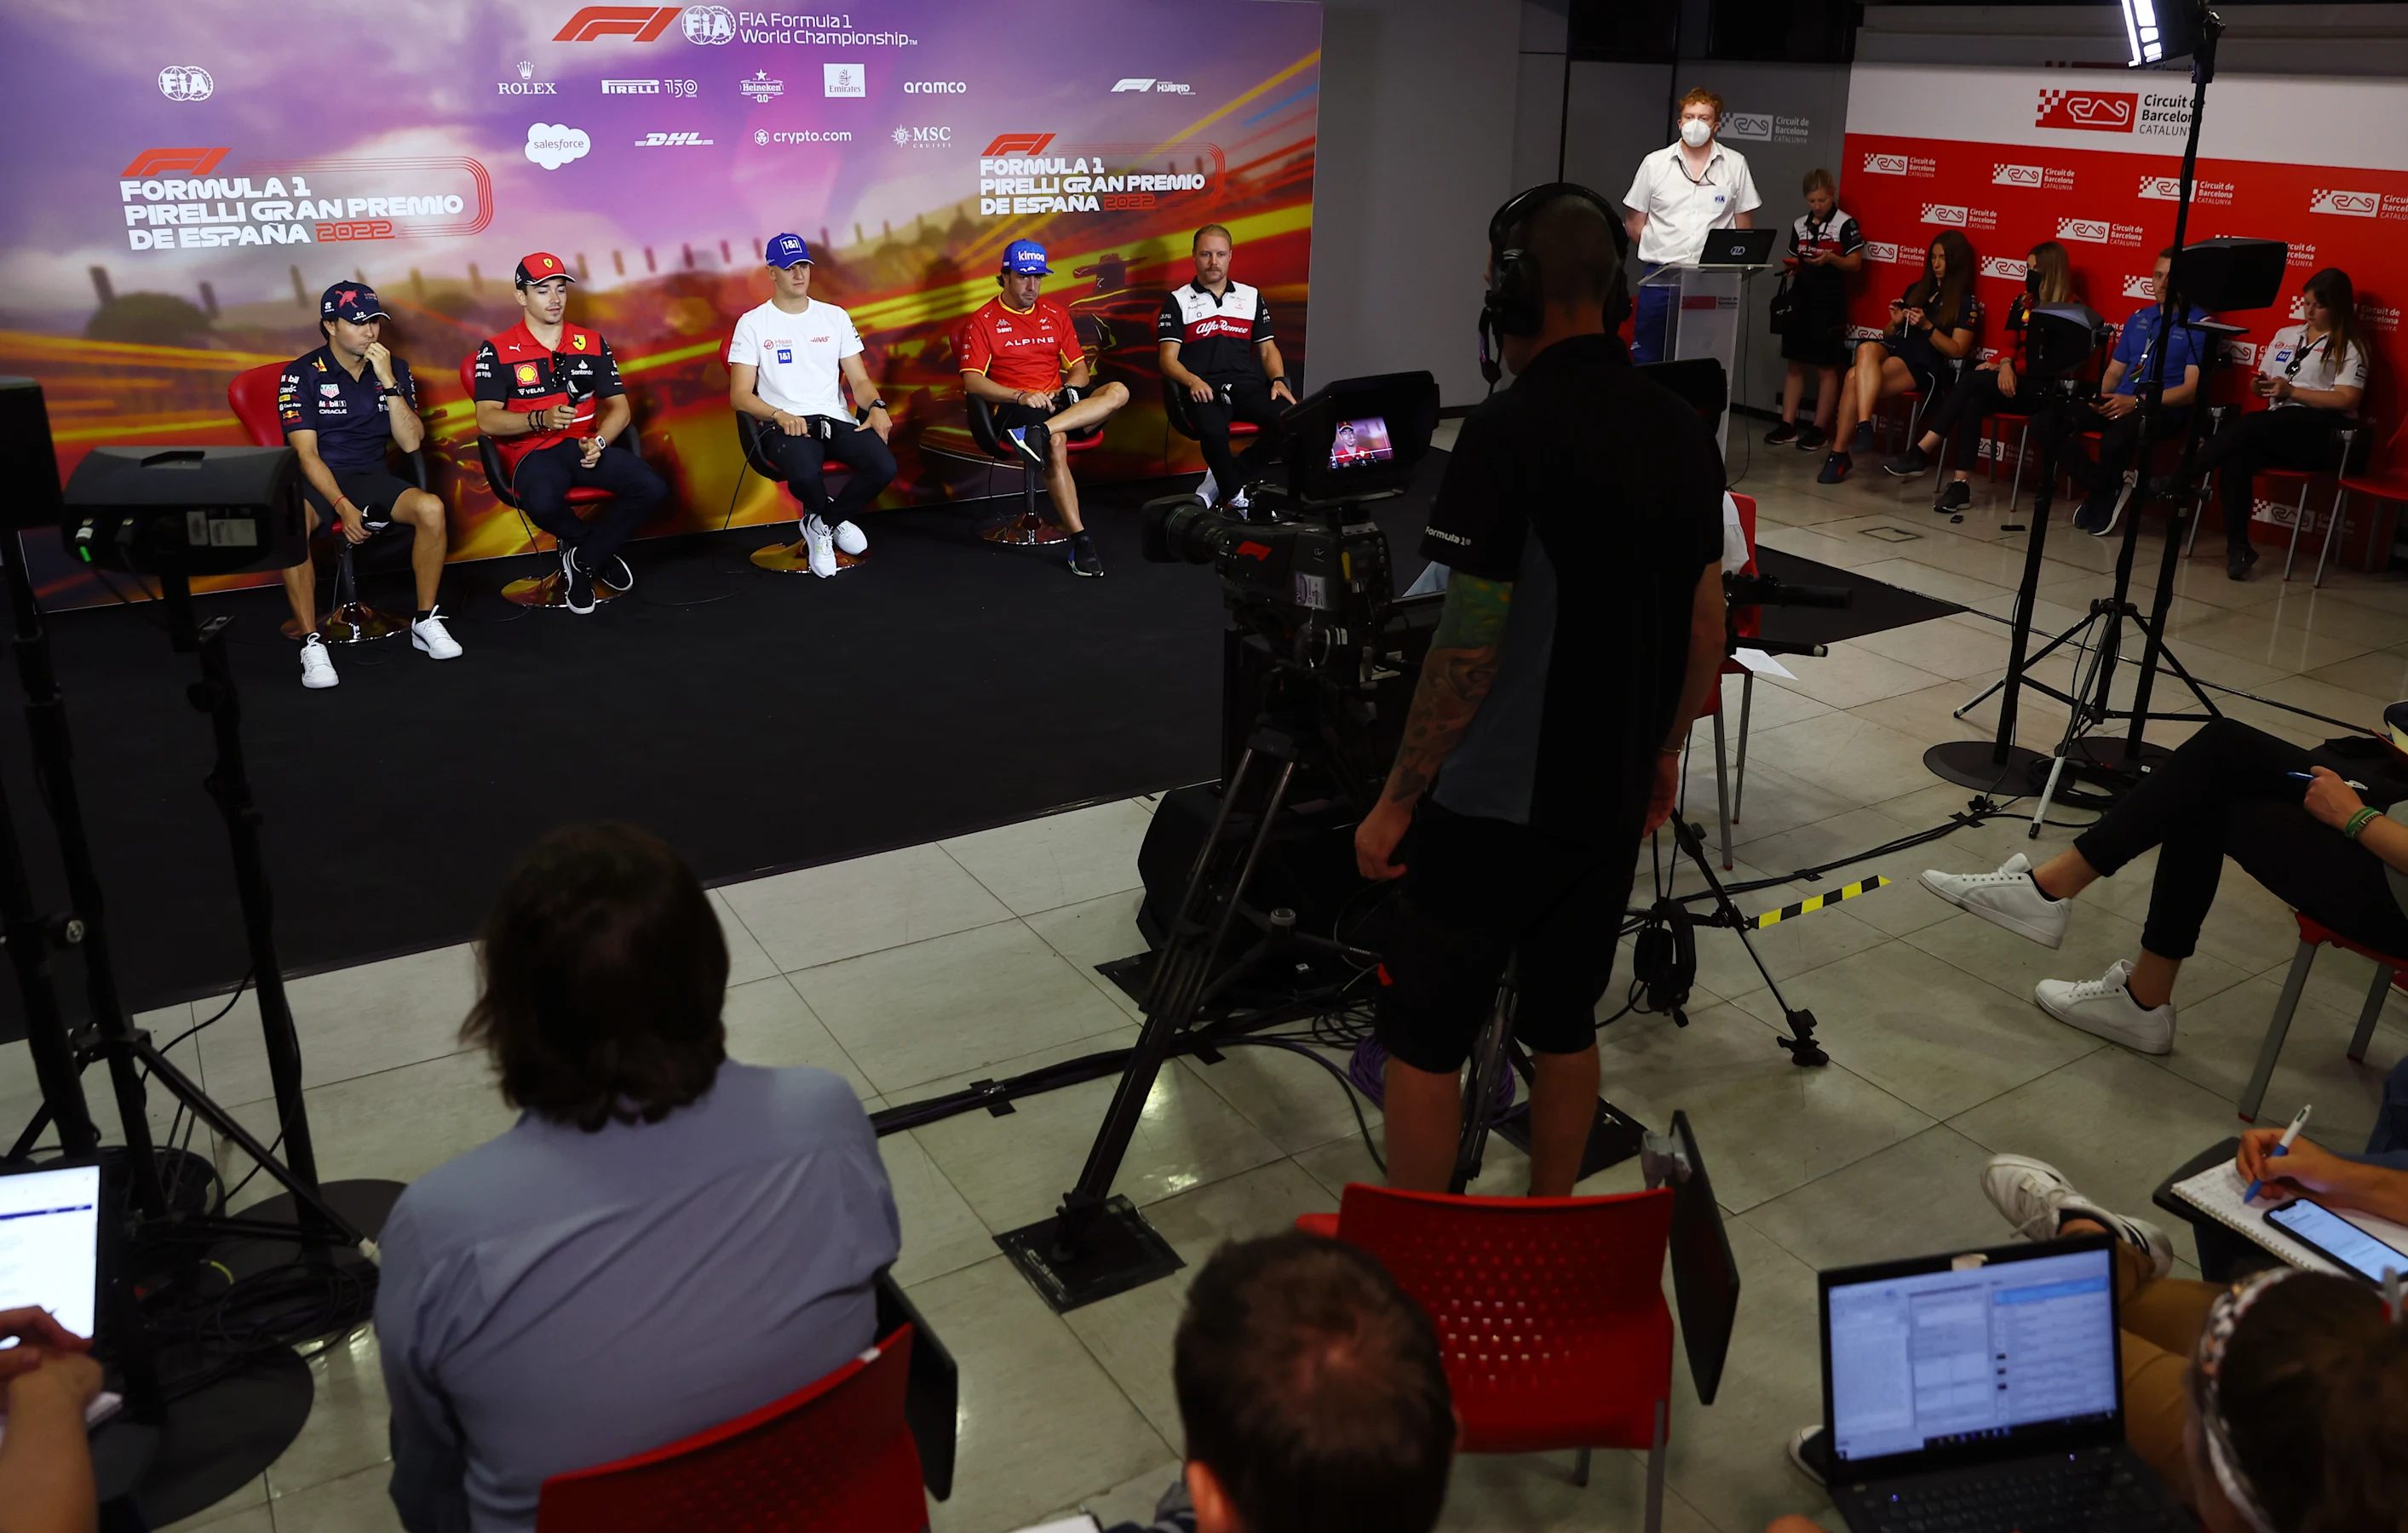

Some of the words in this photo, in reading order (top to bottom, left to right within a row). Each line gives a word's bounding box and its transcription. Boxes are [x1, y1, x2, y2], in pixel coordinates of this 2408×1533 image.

[687, 14, 732, 36] FIA
[739, 12, 768, 26] FIA
[771, 13, 841, 28] Formula
[843, 14, 852, 29] 1
[739, 31, 790, 44] World
[497, 83, 557, 95] ROLEX
[601, 79, 659, 94] PIRELLI
[904, 81, 967, 94] aramco
[757, 95, 768, 103] 0.0
[2144, 95, 2187, 107] Circuit
[1776, 116, 1801, 125] Circuit
[773, 129, 852, 145] crypto.com
[913, 126, 951, 141] MSC
[1775, 127, 1807, 136] Barcelona
[533, 138, 584, 151] salesforce
[646, 132, 705, 146] DHL
[980, 158, 1089, 175] FORMULA
[1093, 157, 1105, 175] 1
[1910, 157, 1928, 165] Circuit
[2045, 168, 2065, 176] Circuit
[980, 177, 1060, 196] PIRELLI
[1063, 175, 1124, 194] GRAN
[1127, 174, 1205, 192] PREMIO
[2044, 175, 2073, 184] Barcelona
[2200, 181, 2223, 190] Circuit
[120, 177, 288, 201] FORMULA
[294, 176, 311, 197] 1
[2198, 189, 2233, 198] Barcelona
[124, 201, 246, 226] PIRELLI
[251, 199, 342, 221] GRAN
[348, 195, 463, 218] PREMIO
[980, 197, 1010, 215] DE
[1013, 194, 1101, 214] ESPAÑA
[1103, 194, 1157, 210] 2022
[1970, 208, 1989, 216] Circuit
[1969, 215, 1996, 224] Barcelona
[2112, 223, 2132, 233] Circuit
[2134, 225, 2143, 233] de
[129, 228, 175, 250] DE
[180, 222, 312, 248] ESPAÑA
[315, 221, 395, 243] 2022
[2112, 232, 2142, 240] Barcelona
[783, 238, 799, 249] 1&1
[1900, 245, 1916, 254] Circuit
[1196, 320, 1218, 336] Alfa
[1220, 319, 1248, 333] Romeo
[1005, 336, 1055, 347] ALPINE
[779, 352, 790, 360] 1&1
[281, 375, 300, 384] Mobil
[1426, 526, 1459, 544] Formula
